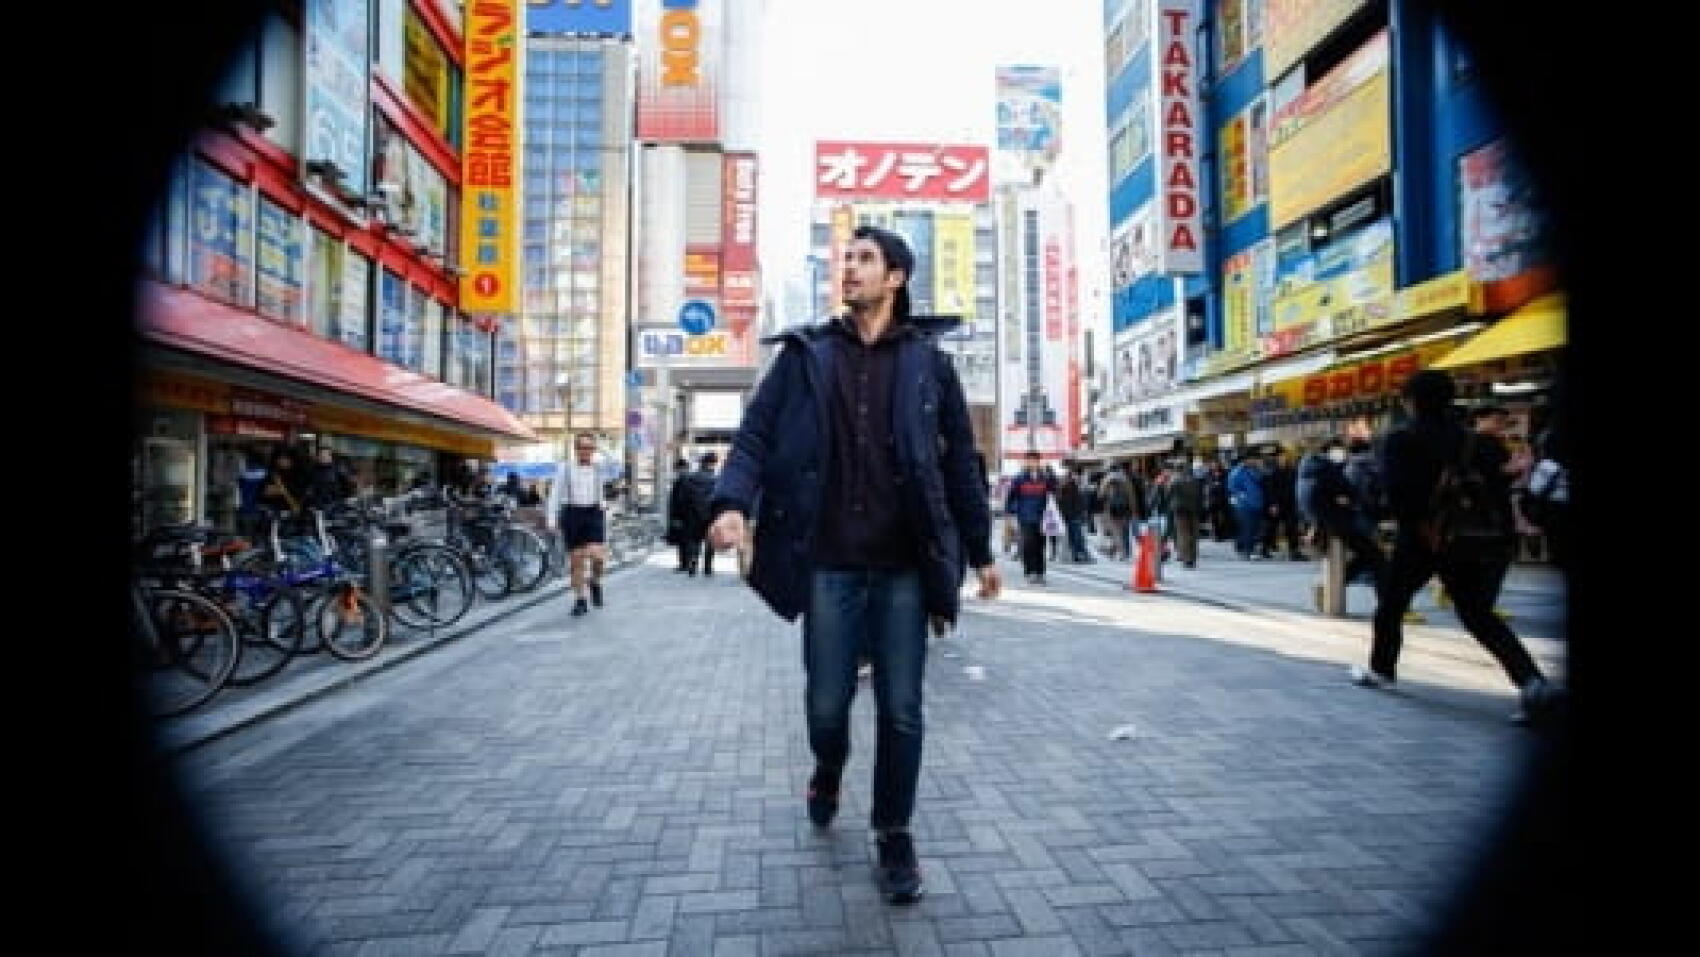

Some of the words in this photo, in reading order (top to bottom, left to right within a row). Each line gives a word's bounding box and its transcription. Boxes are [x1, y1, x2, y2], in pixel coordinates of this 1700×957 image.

[659, 0, 700, 88] OX
[818, 143, 988, 193] オノデン
[1162, 9, 1198, 251] TAKARADA
